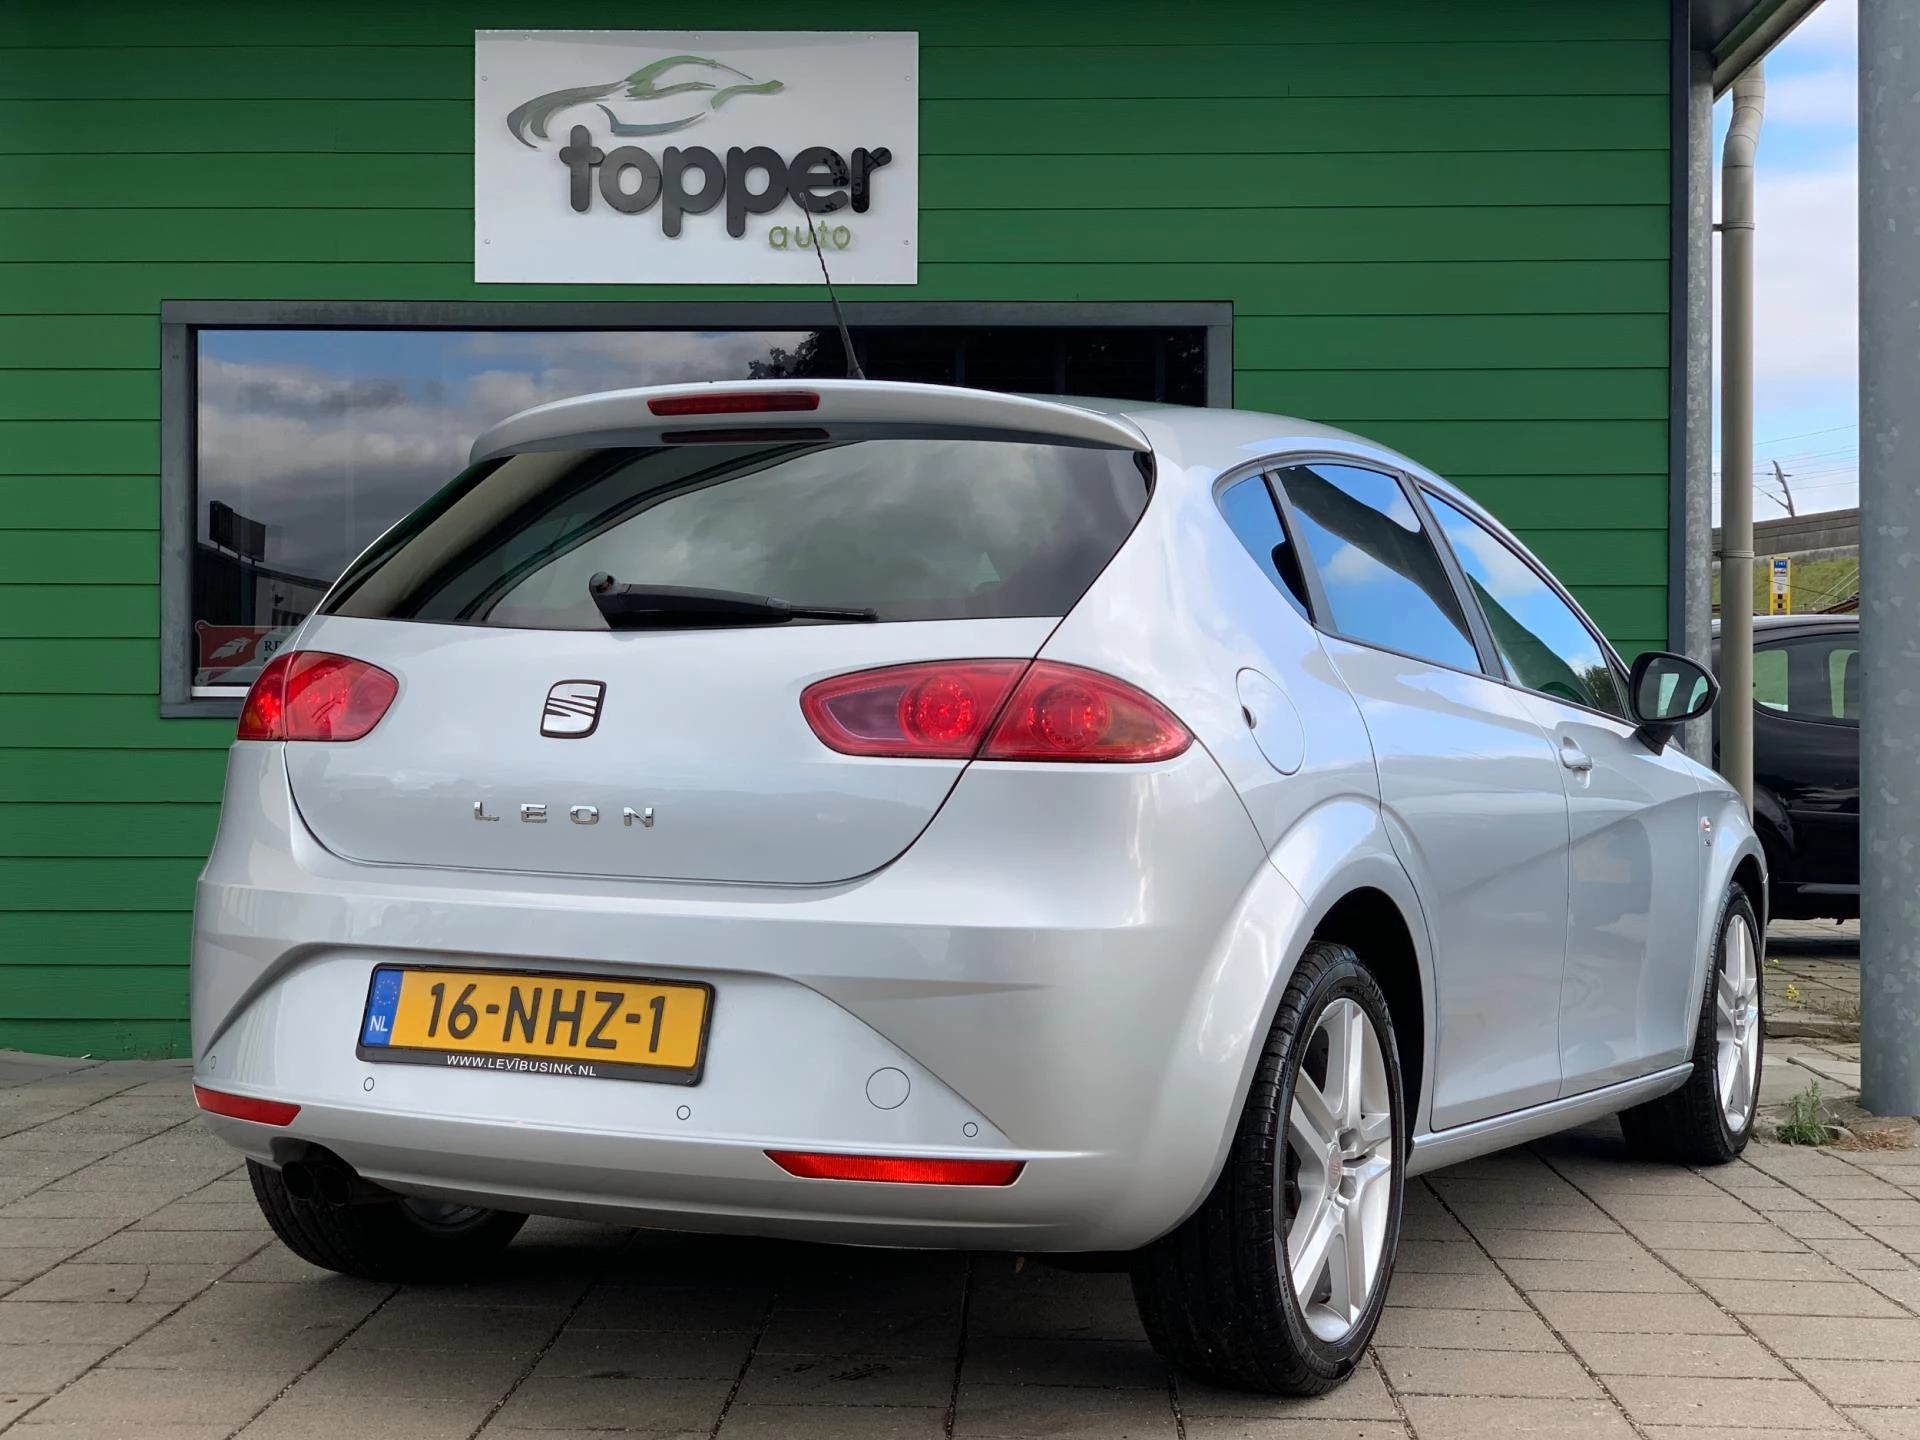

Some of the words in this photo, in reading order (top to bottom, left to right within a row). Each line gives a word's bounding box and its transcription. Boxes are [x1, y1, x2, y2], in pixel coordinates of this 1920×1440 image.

[559, 124, 892, 238] topper
[768, 220, 852, 250] auto
[474, 801, 654, 827] LEON
[369, 1015, 389, 1032] NL
[427, 982, 666, 1053] 16-NHZ-1
